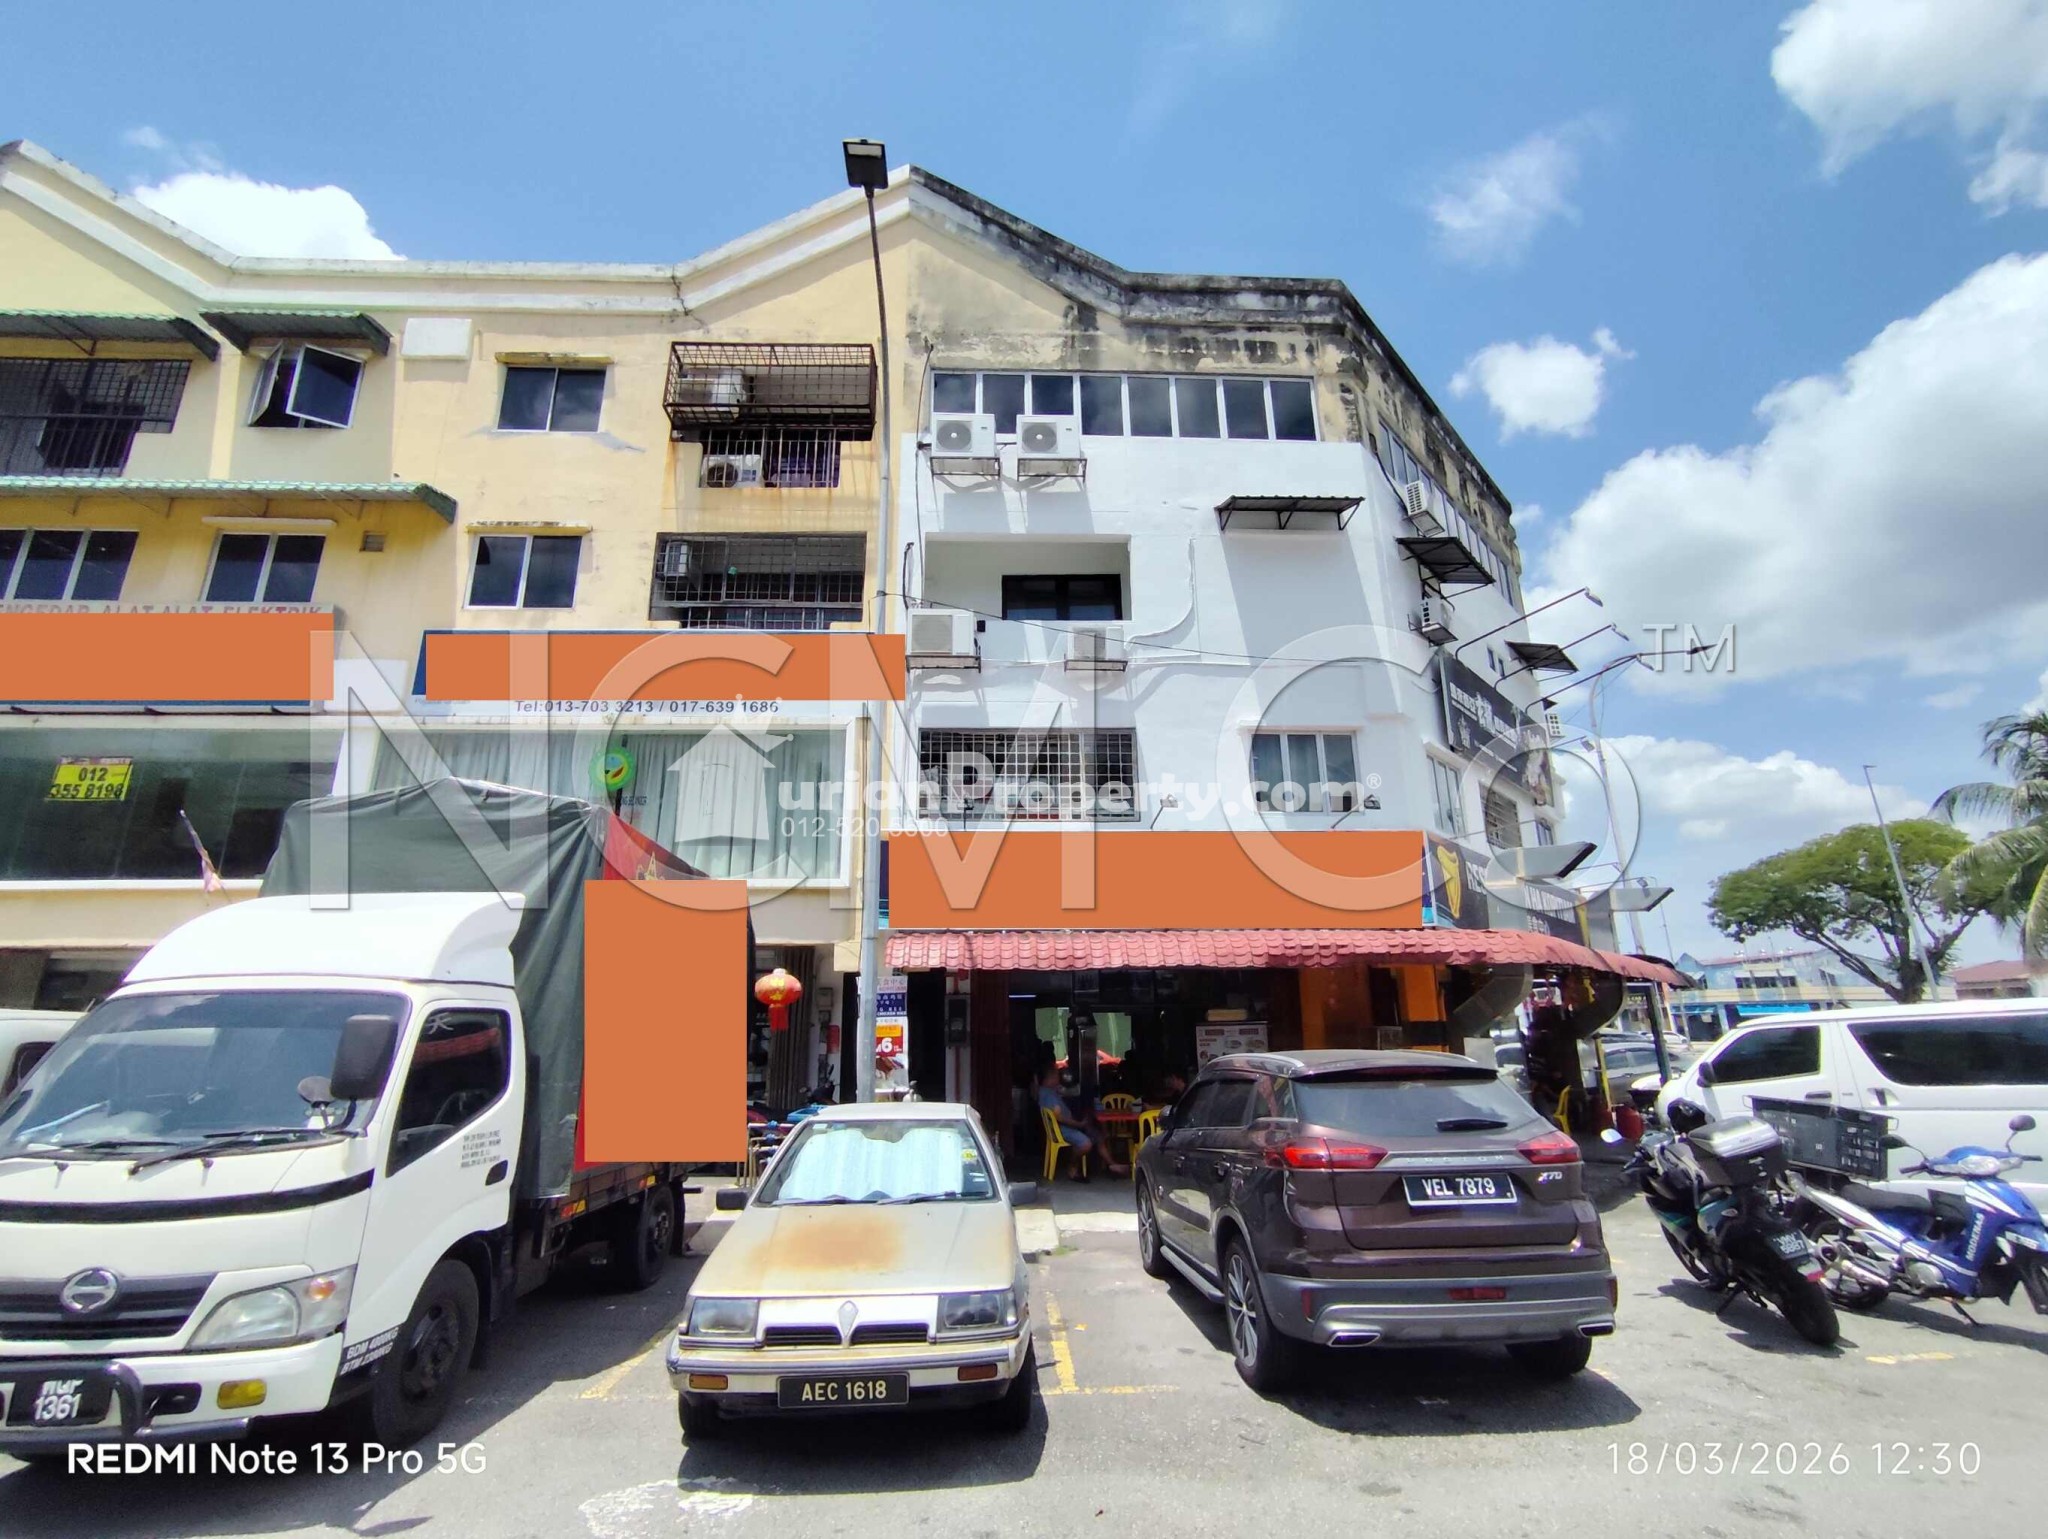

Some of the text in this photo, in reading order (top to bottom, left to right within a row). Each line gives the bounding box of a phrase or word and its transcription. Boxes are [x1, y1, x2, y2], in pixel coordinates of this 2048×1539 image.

[614, 700, 654, 713] 3213
[669, 701, 735, 713] 017-639
[741, 701, 779, 713] 1686
[78, 767, 109, 782] 012
[1422, 1177, 1496, 1197] VEL 7879
[802, 1380, 887, 1401] AEC 1618
[34, 1394, 82, 1420] 1361
